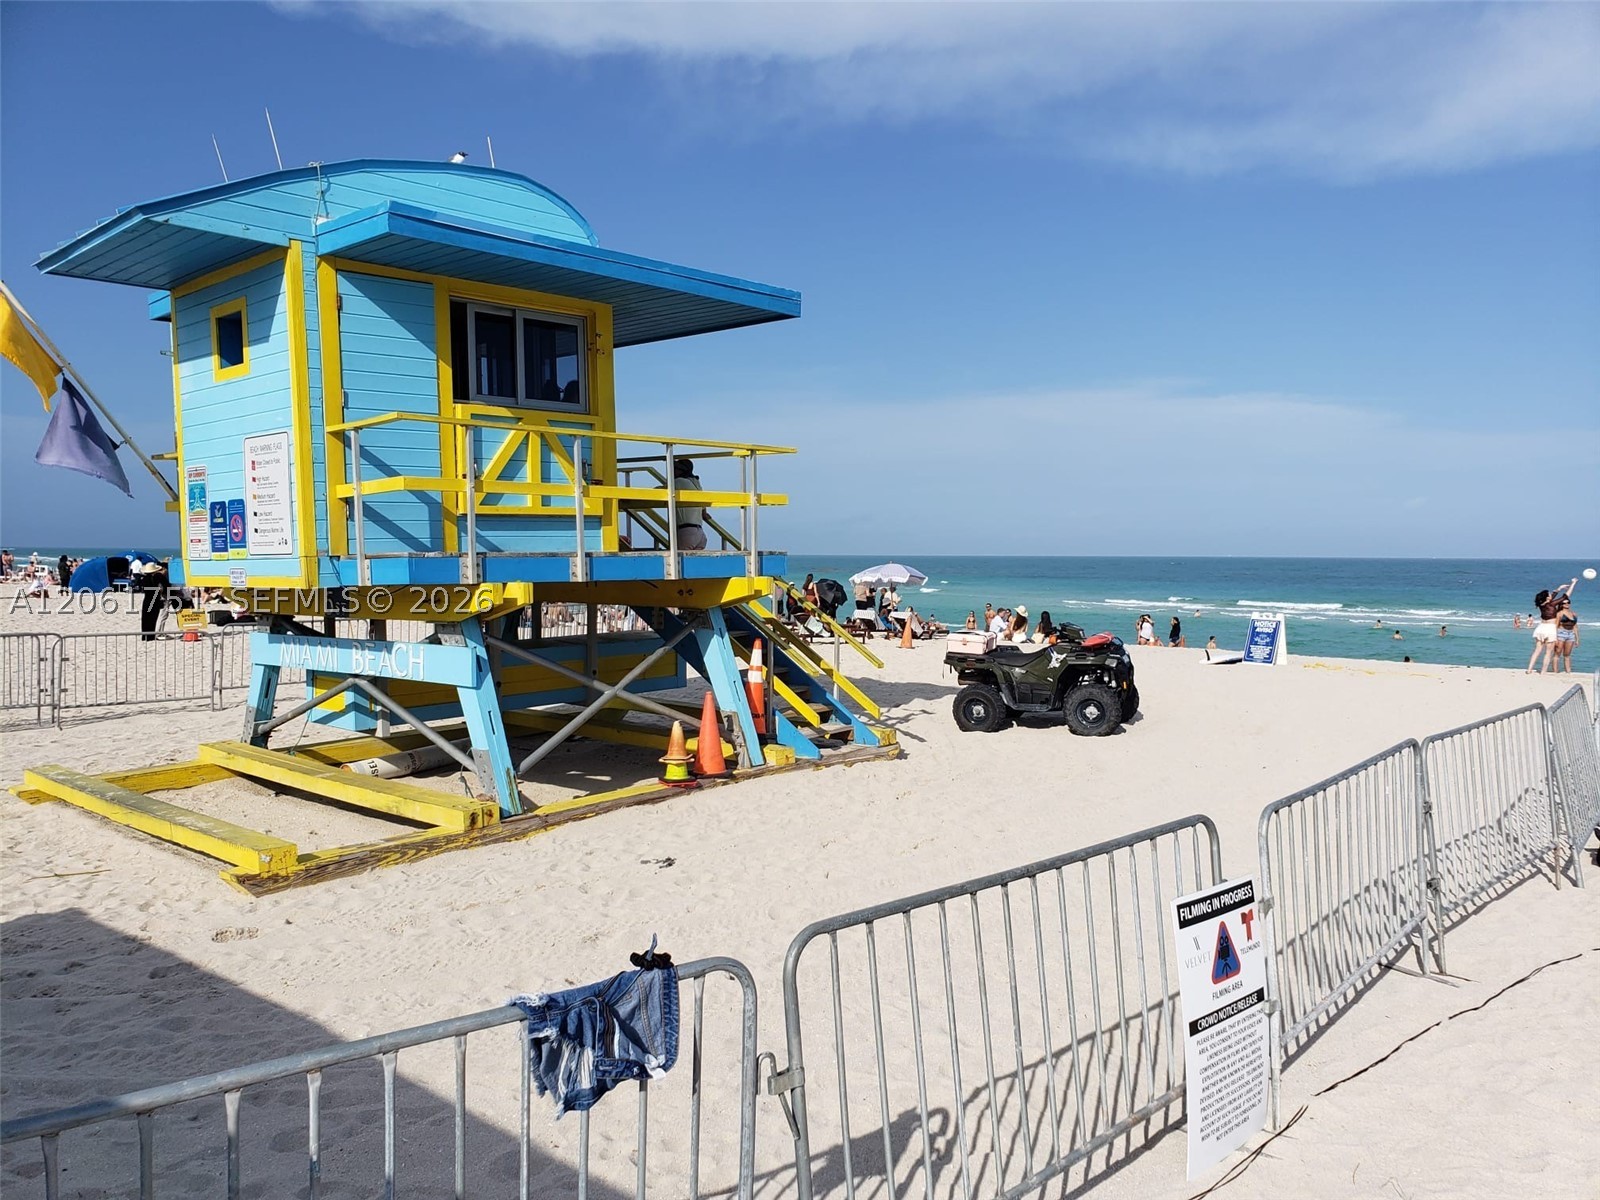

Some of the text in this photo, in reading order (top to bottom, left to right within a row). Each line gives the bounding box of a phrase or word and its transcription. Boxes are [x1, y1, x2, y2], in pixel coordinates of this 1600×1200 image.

[280, 640, 424, 680] MIAMI BEACH
[1180, 885, 1253, 921] FILMING IN PROGRESS
[1240, 941, 1261, 955] TELEMUNDO
[1184, 951, 1212, 969] VELVET
[1212, 980, 1243, 1000] FILMING AREA
[1198, 1013, 1218, 1030] CROWD
